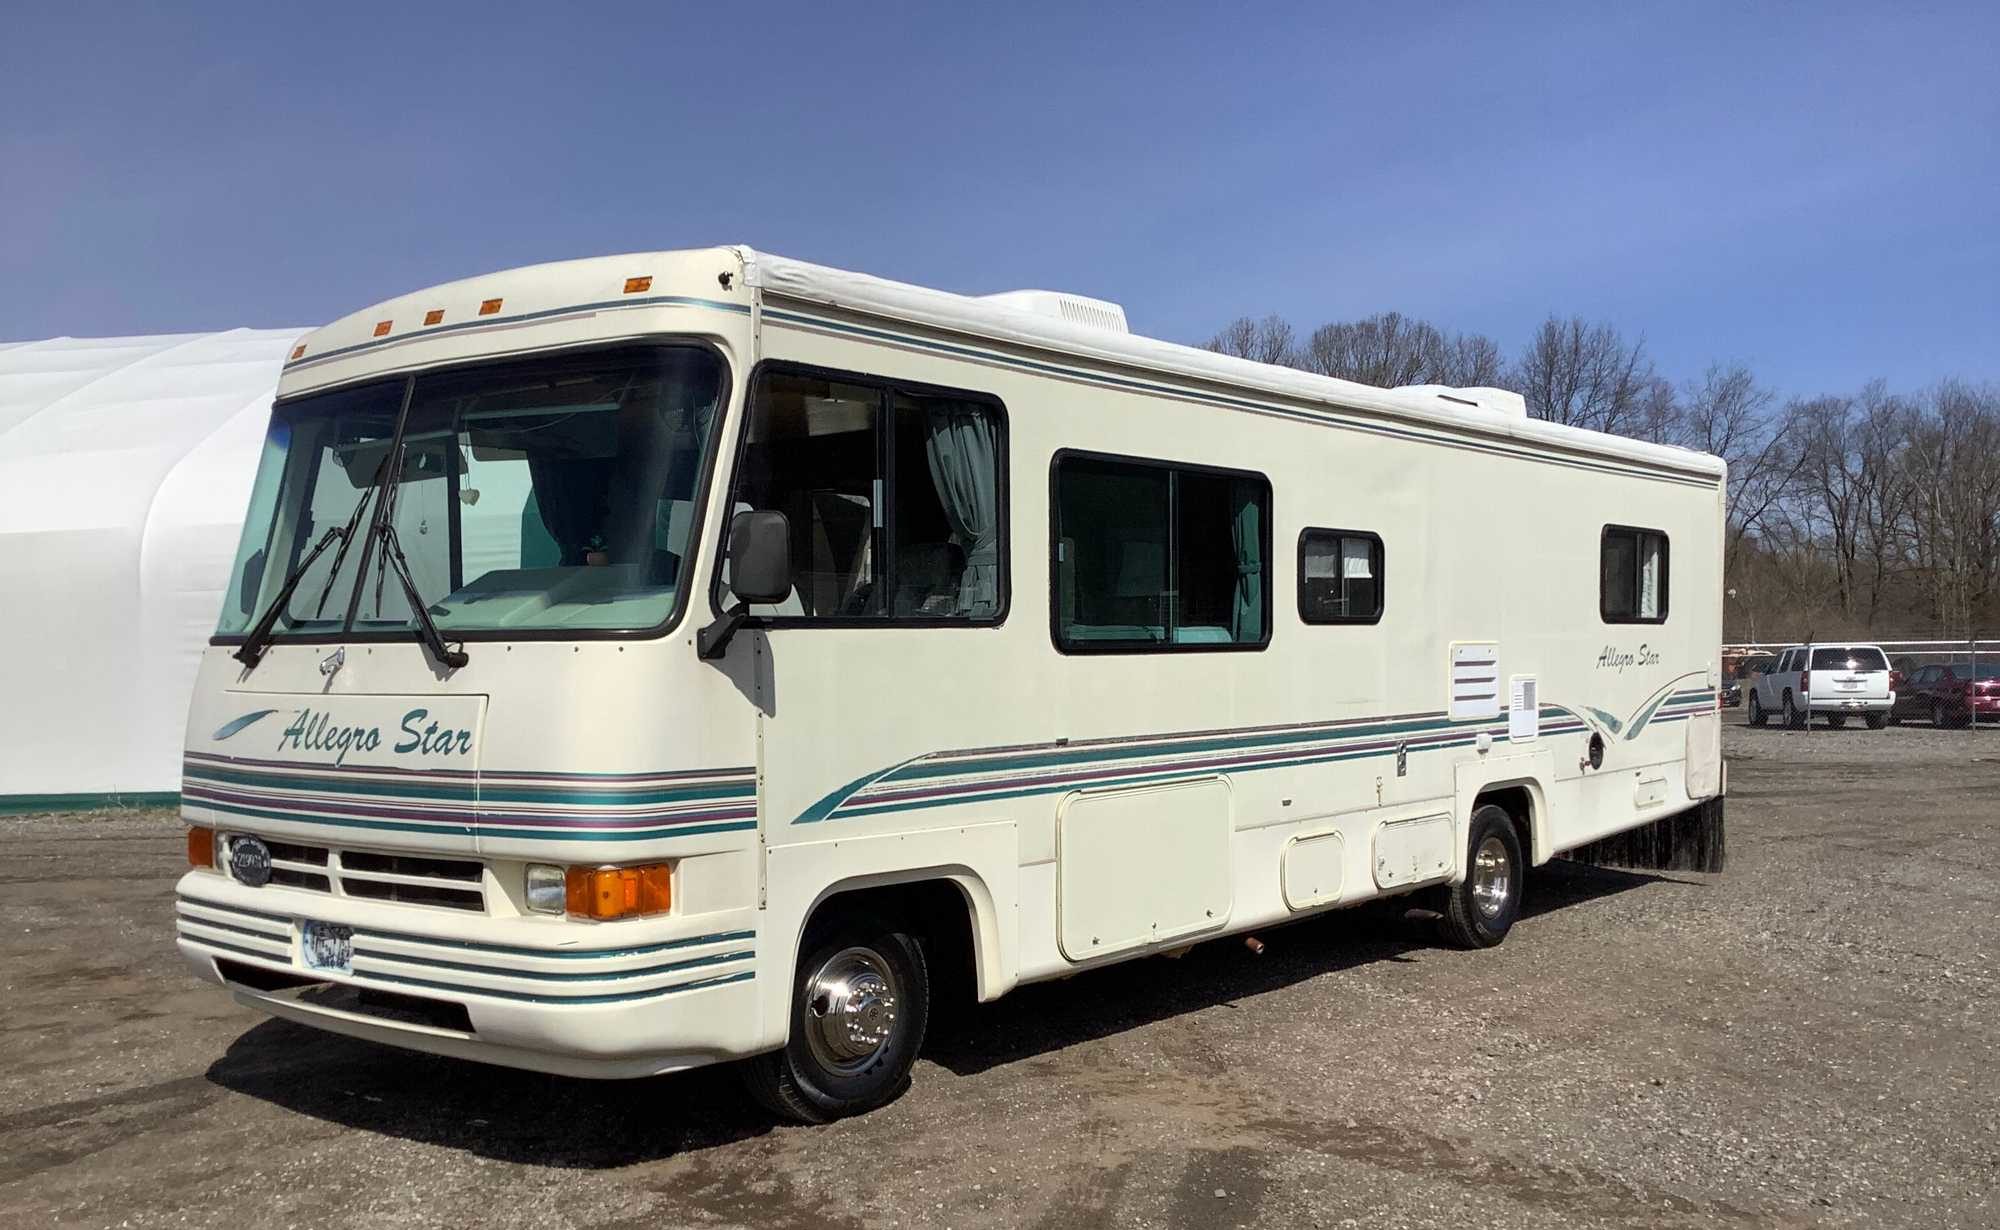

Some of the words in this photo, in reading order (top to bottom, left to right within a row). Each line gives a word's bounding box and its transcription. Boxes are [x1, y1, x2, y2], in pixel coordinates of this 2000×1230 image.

[1596, 645, 1633, 674] Allegro
[1638, 643, 1660, 666] Star
[277, 708, 381, 766] Allegro
[394, 709, 472, 755] Star
